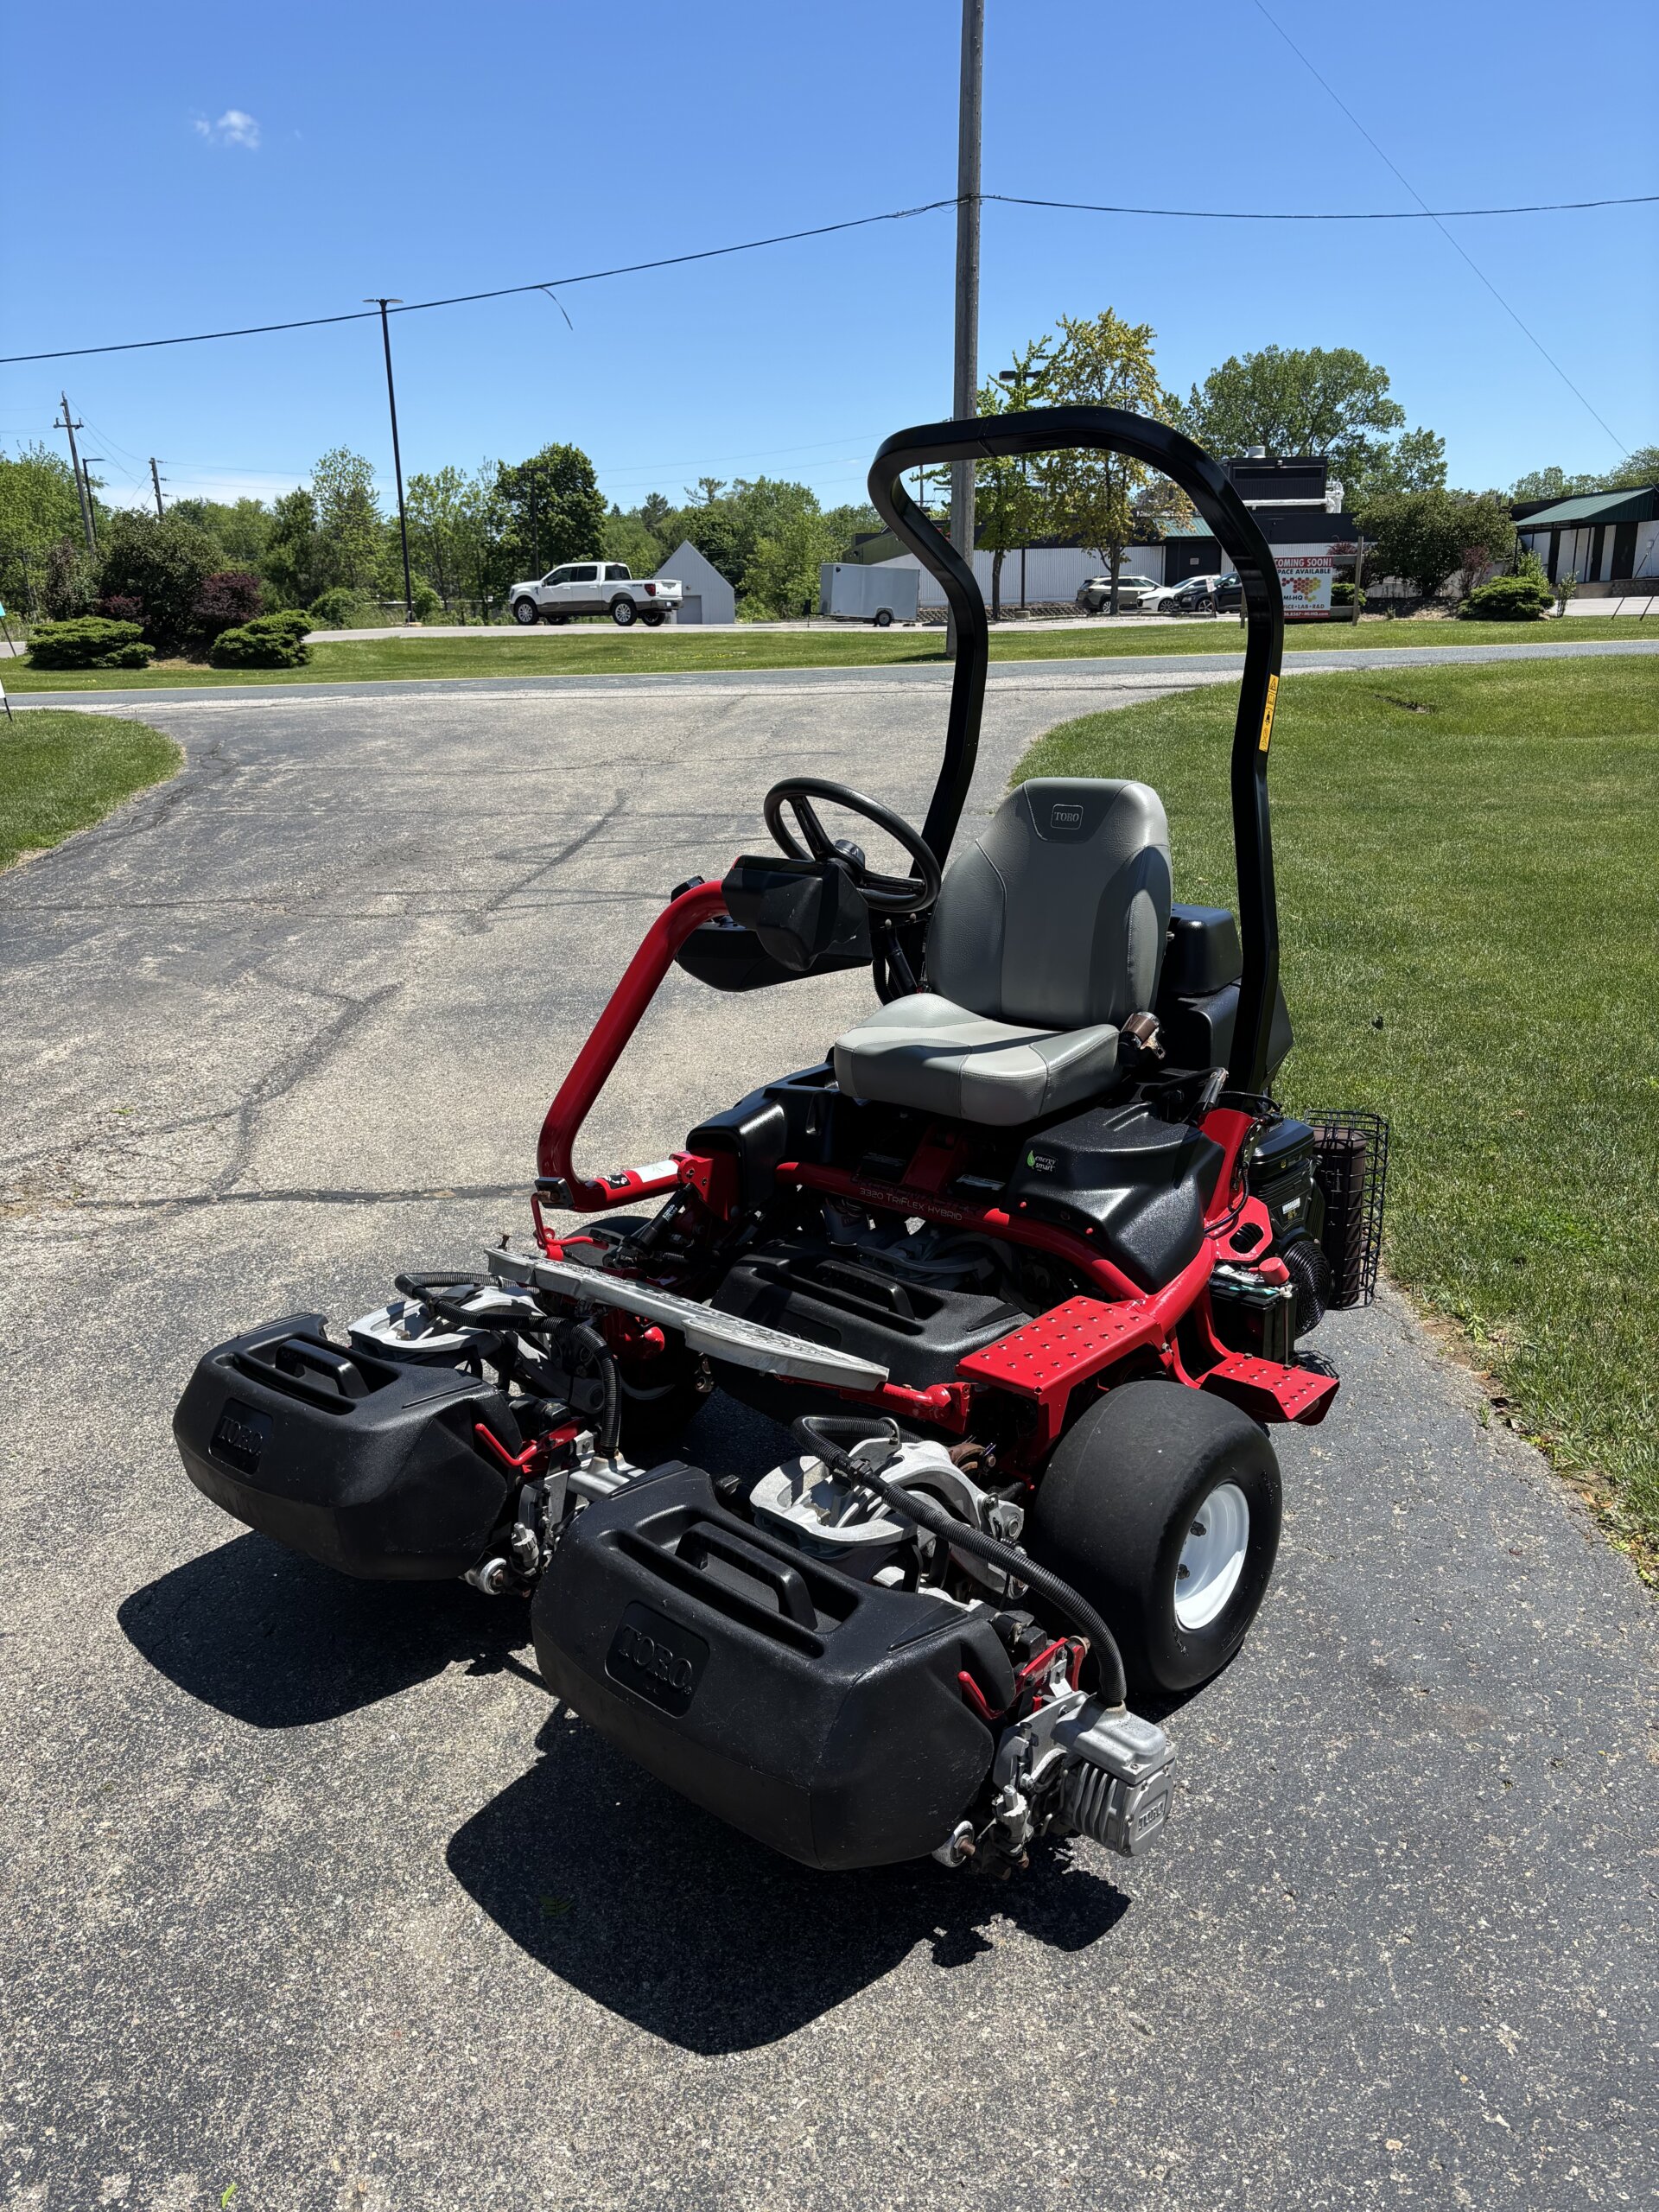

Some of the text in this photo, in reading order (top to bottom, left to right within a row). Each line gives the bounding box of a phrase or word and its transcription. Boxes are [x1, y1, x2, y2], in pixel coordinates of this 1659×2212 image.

[1274, 557, 1332, 568] COMING SOON!
[1053, 811, 1079, 823] TORO
[1035, 1155, 1056, 1166] energy
[1035, 1162, 1053, 1173] smart
[859, 1186, 884, 1200] 3320
[927, 1205, 963, 1221] HYBRID
[217, 1415, 263, 1454] TORO
[618, 1624, 692, 1689] TORO
[1138, 1801, 1164, 1831] TORO
